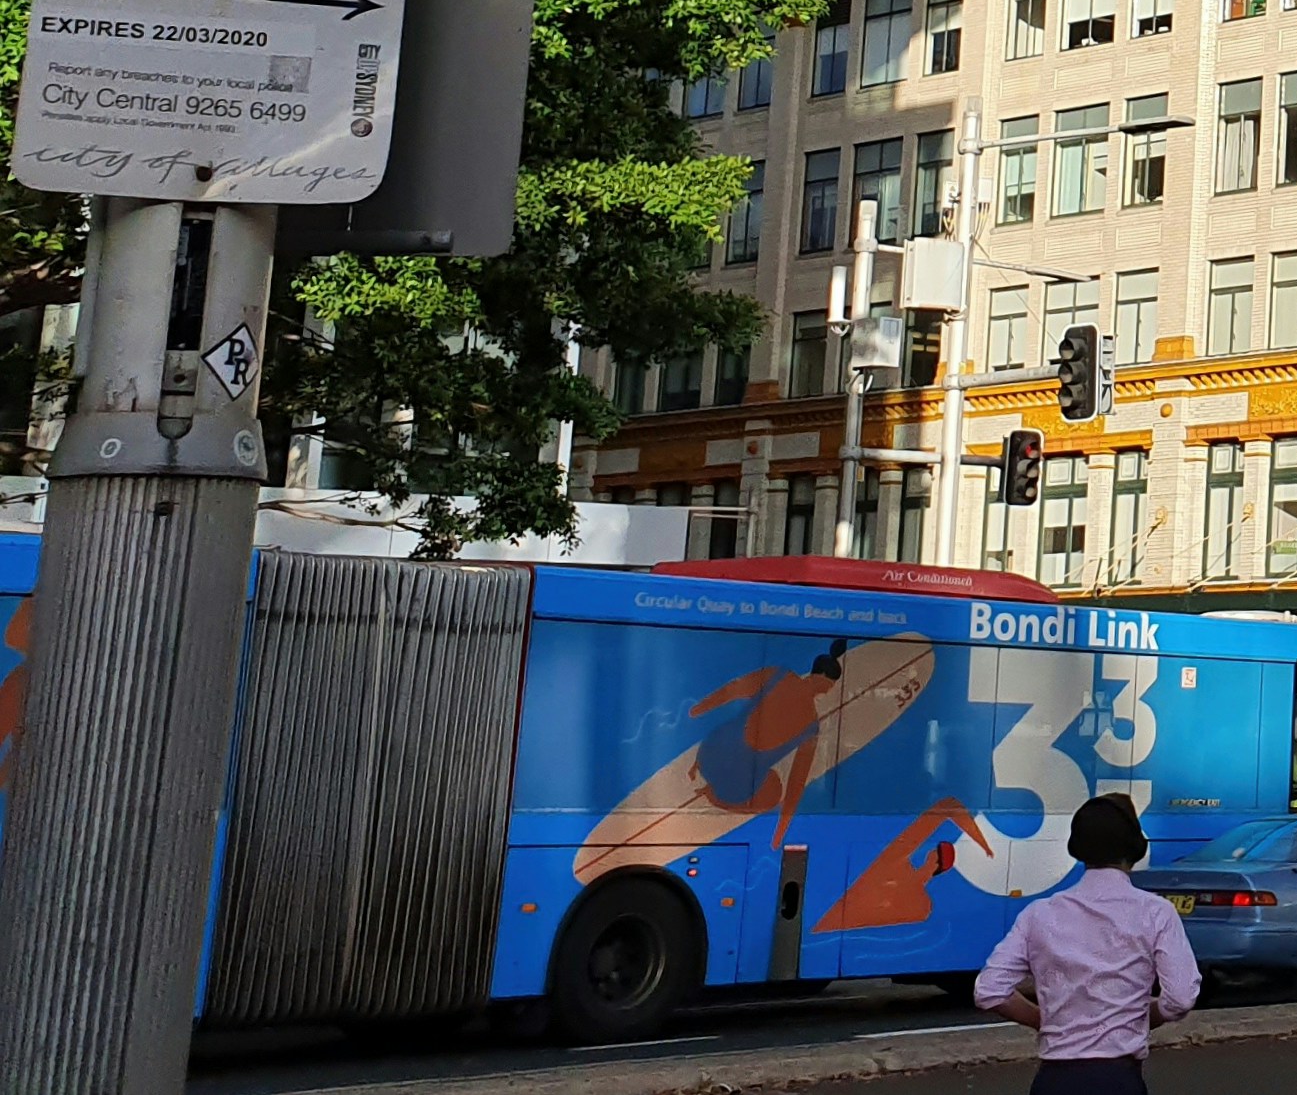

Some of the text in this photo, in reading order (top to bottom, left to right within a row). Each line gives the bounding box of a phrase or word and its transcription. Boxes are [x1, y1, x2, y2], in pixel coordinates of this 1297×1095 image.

[40, 16, 268, 47] EXPIRES 22/03/2020
[48, 61, 92, 78] Report
[95, 67, 119, 81] any
[120, 69, 179, 84] breaches
[182, 73, 194, 85] to
[197, 76, 223, 90] your
[226, 78, 254, 91] local
[42, 83, 307, 123] City Central 9265 6499
[352, 72, 379, 120] SYDNEY
[23, 143, 135, 179] city
[141, 148, 196, 185] of
[881, 569, 973, 587] Air Conditioned
[634, 591, 693, 610] Circular
[697, 594, 735, 616] Quay
[740, 601, 755, 614] to
[759, 600, 800, 617] Bondi
[804, 603, 844, 621] Beach
[848, 607, 874, 623] and
[970, 601, 1160, 651] Bondi Link
[894, 677, 921, 710] 333
